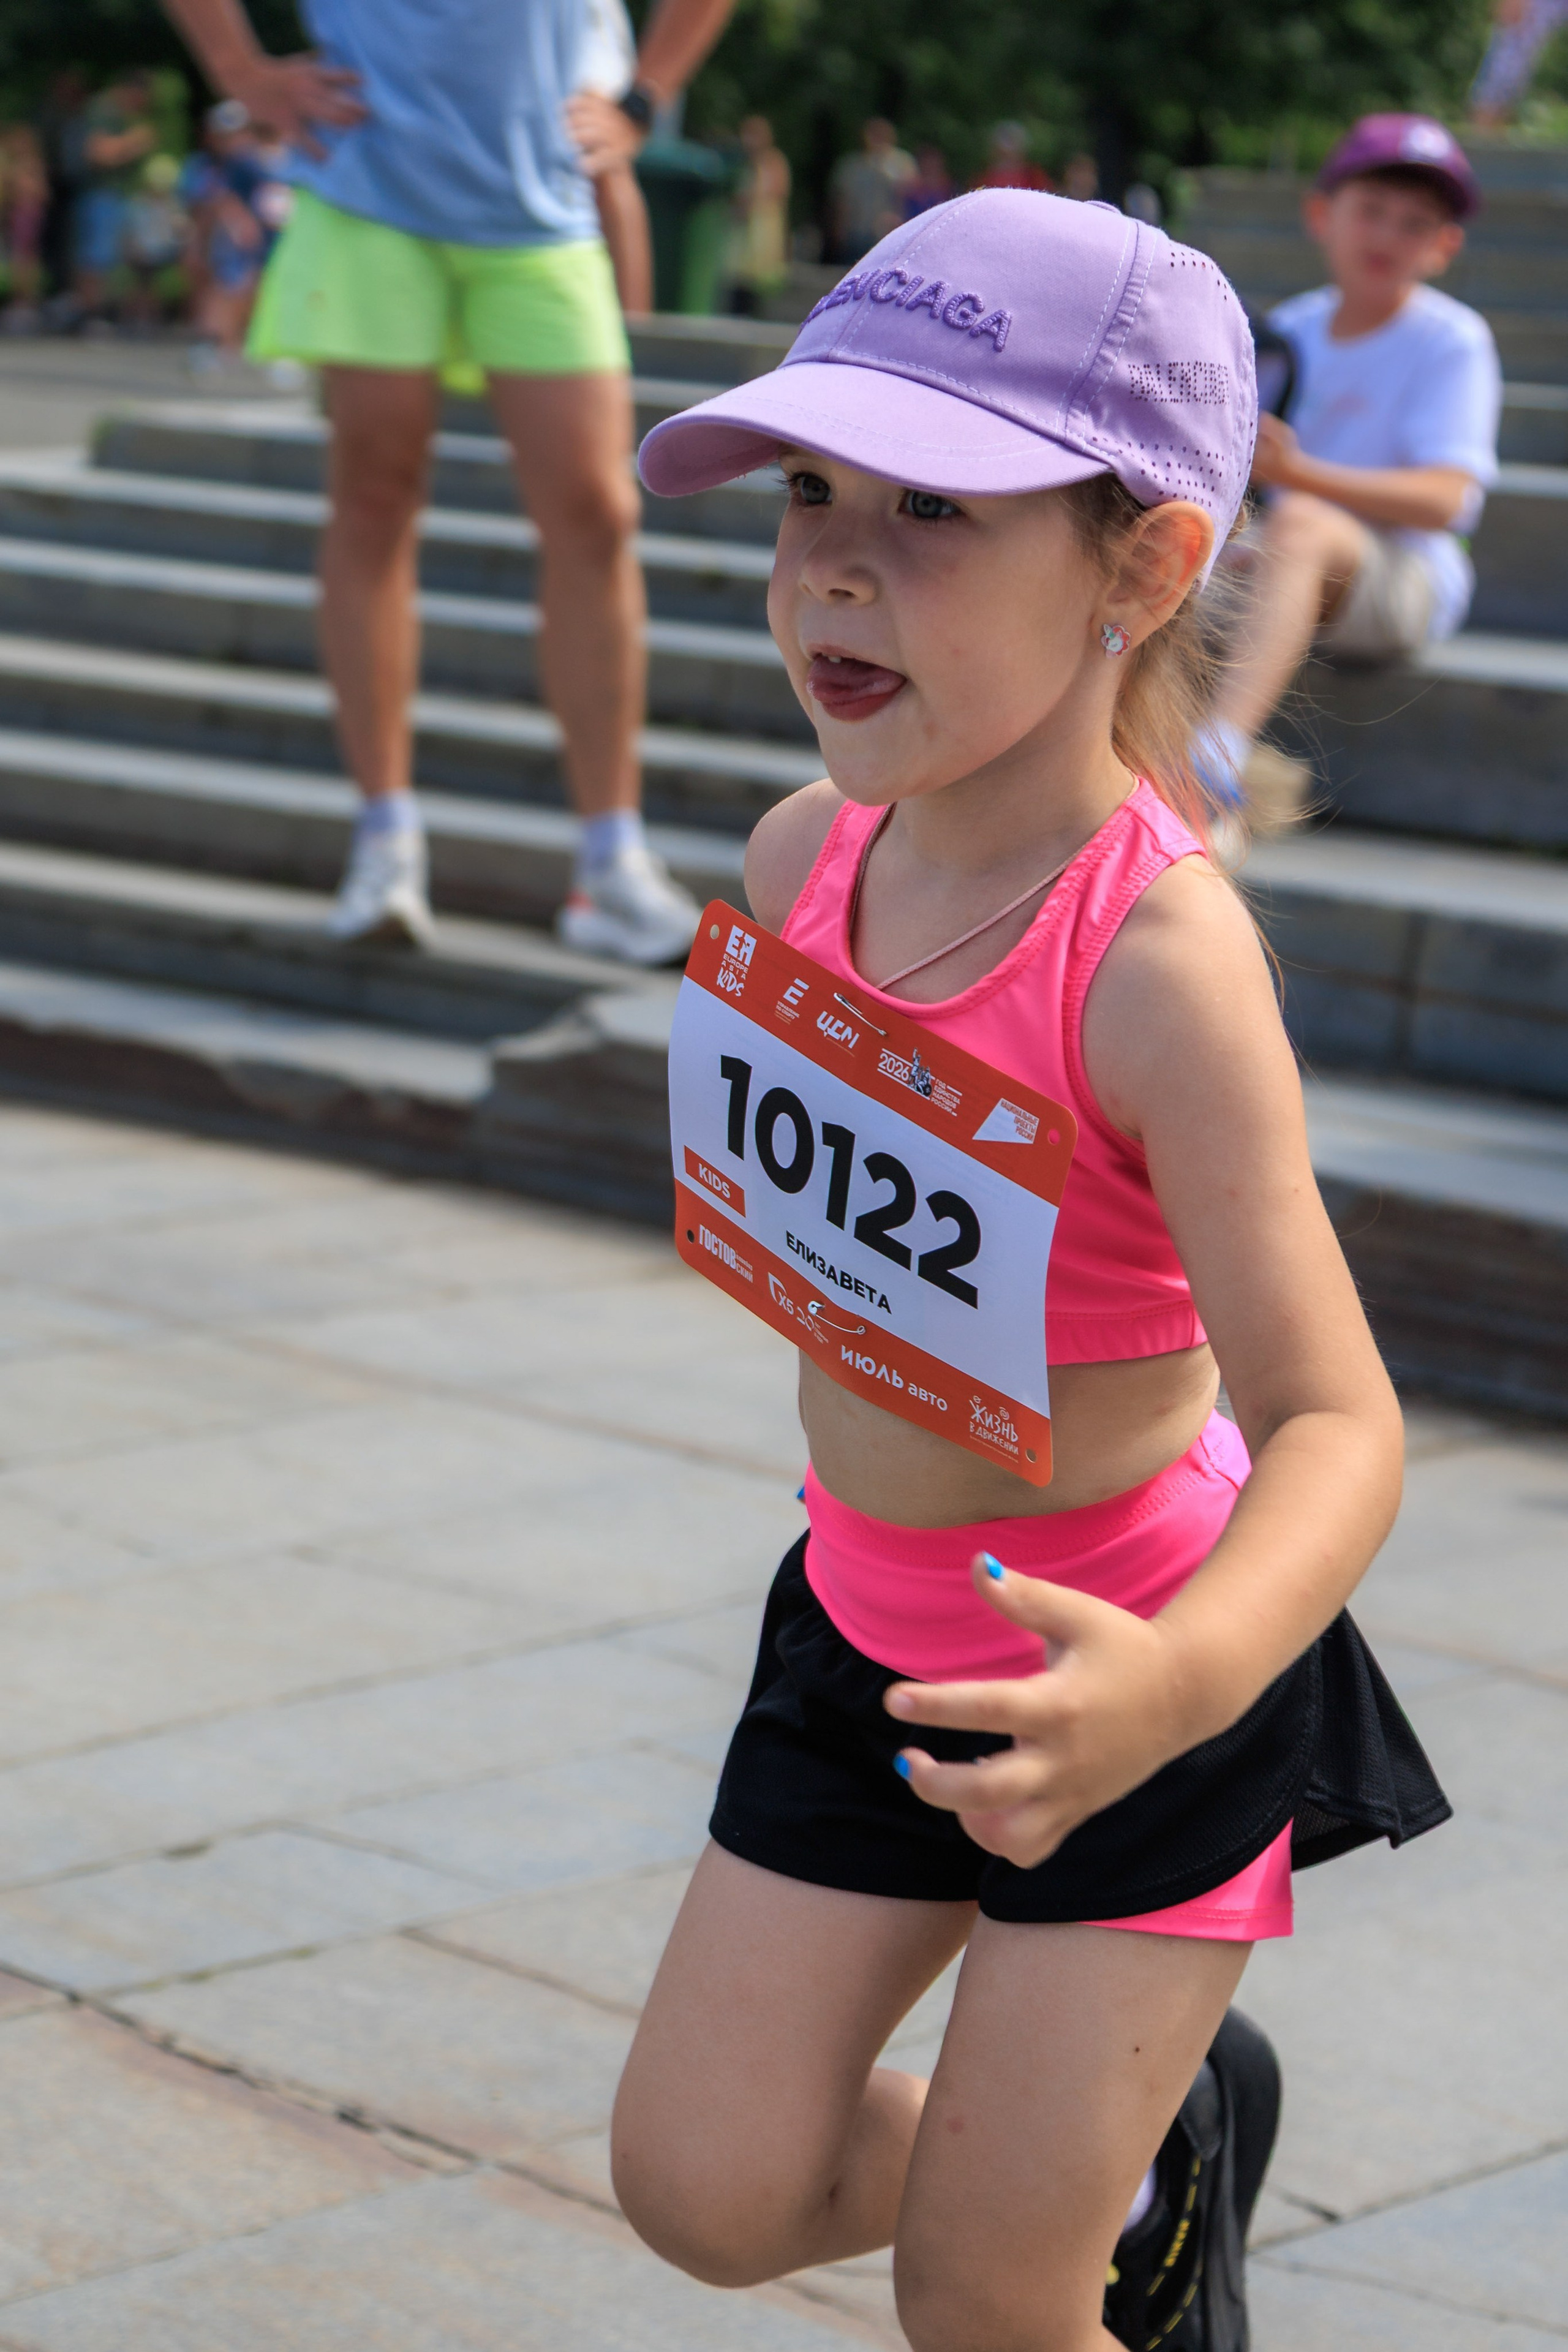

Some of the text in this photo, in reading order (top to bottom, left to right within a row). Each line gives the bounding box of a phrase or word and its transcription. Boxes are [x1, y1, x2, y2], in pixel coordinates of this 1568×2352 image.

[723, 953, 748, 973] EUROPE
[878, 1053, 910, 1081] 2026
[699, 1163, 731, 1199] KIDS
[721, 1054, 981, 1310] 10122
[786, 1230, 892, 1315] ЕЛИЗАВЕТА
[778, 1291, 794, 1315] X5
[841, 1344, 948, 1411] ИЮЛЬ авто
[969, 1400, 1019, 1442] ЖИЗНЬ
